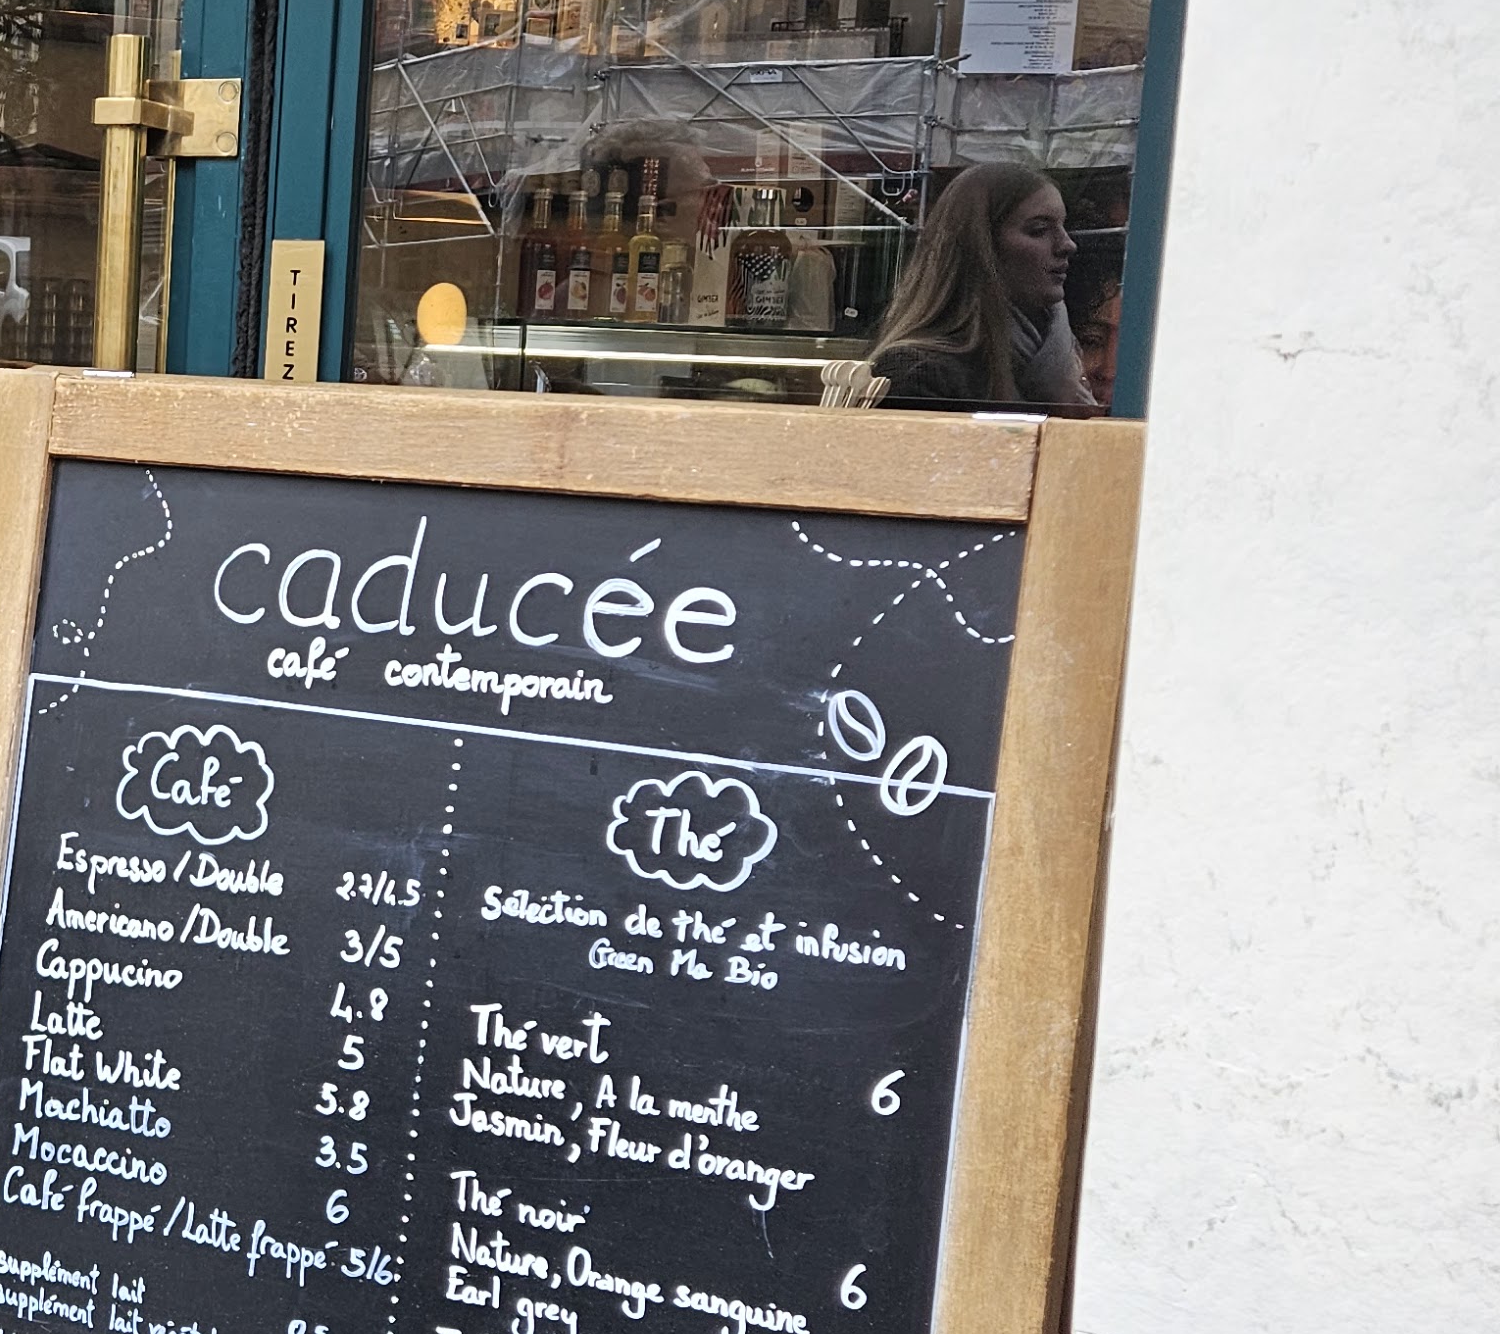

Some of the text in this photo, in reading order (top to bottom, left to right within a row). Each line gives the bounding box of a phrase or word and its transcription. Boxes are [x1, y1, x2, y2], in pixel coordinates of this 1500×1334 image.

[282, 269, 301, 380] TIREZ
[213, 517, 737, 662] caducée
[267, 637, 614, 715] café contemporain
[151, 752, 243, 807] Café
[57, 832, 167, 894] Espresso
[645, 806, 737, 862] Thé
[47, 888, 404, 969] Americano 3/5
[625, 904, 664, 939] de
[672, 910, 737, 945] thé
[740, 911, 787, 953] et
[795, 921, 907, 971] infusion
[36, 938, 389, 1023] Cappucino 4.8
[724, 955, 779, 991] Bio
[31, 990, 365, 1071] Latte 5
[470, 1002, 612, 1064] Thé vert
[22, 1034, 370, 1121] Flat White 5.8
[596, 1069, 906, 1133] A la menthe 6
[19, 1077, 369, 1175] Machiatto 3.5
[588, 1116, 662, 1165] Fleur
[12, 1123, 350, 1224] Mocaccino 6
[450, 1170, 591, 1234] Thé noir
[3, 1166, 394, 1286] Café frappé frappé 5/6
[112, 1273, 146, 1304] lait
[445, 1265, 501, 1310] Earl
[566, 1245, 665, 1320] Orange
[840, 1263, 868, 1310] 6
